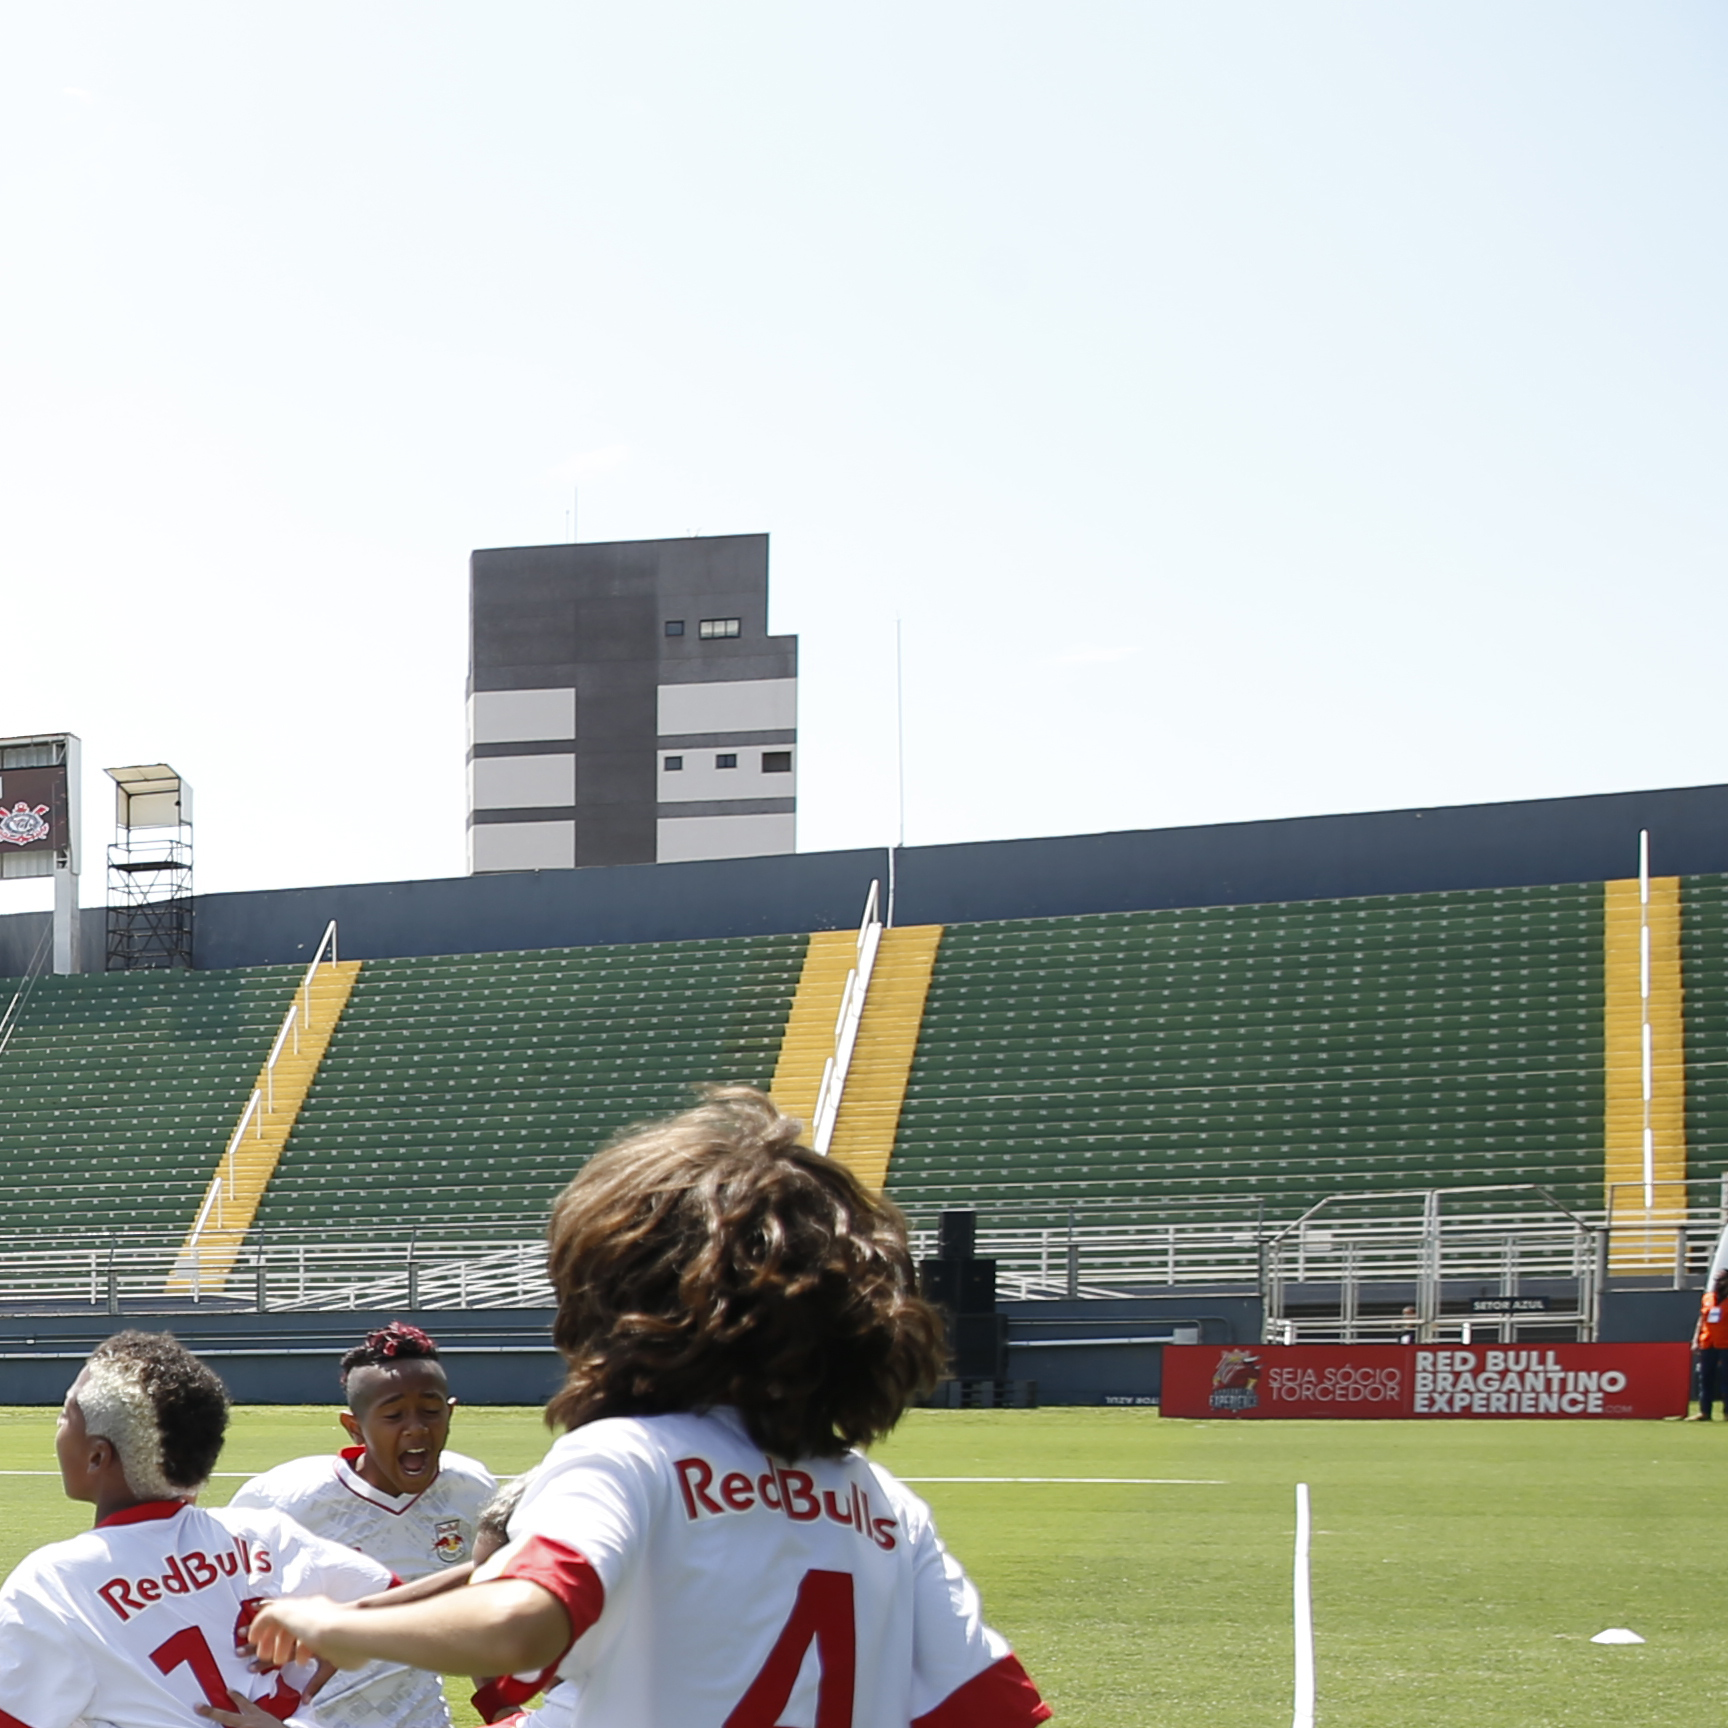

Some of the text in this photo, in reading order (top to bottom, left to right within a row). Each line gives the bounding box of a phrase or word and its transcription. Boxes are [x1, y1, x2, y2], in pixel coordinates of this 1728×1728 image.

[1473, 1300, 1544, 1311] SETOR AZUL
[1415, 1350, 1562, 1372] RED BULL
[1269, 1363, 1401, 1385] SEJA SÓCIO
[1415, 1371, 1627, 1393] BRAGANTINO
[1269, 1384, 1400, 1401] TORCEDOR
[1413, 1392, 1604, 1413] EXPERIENCE
